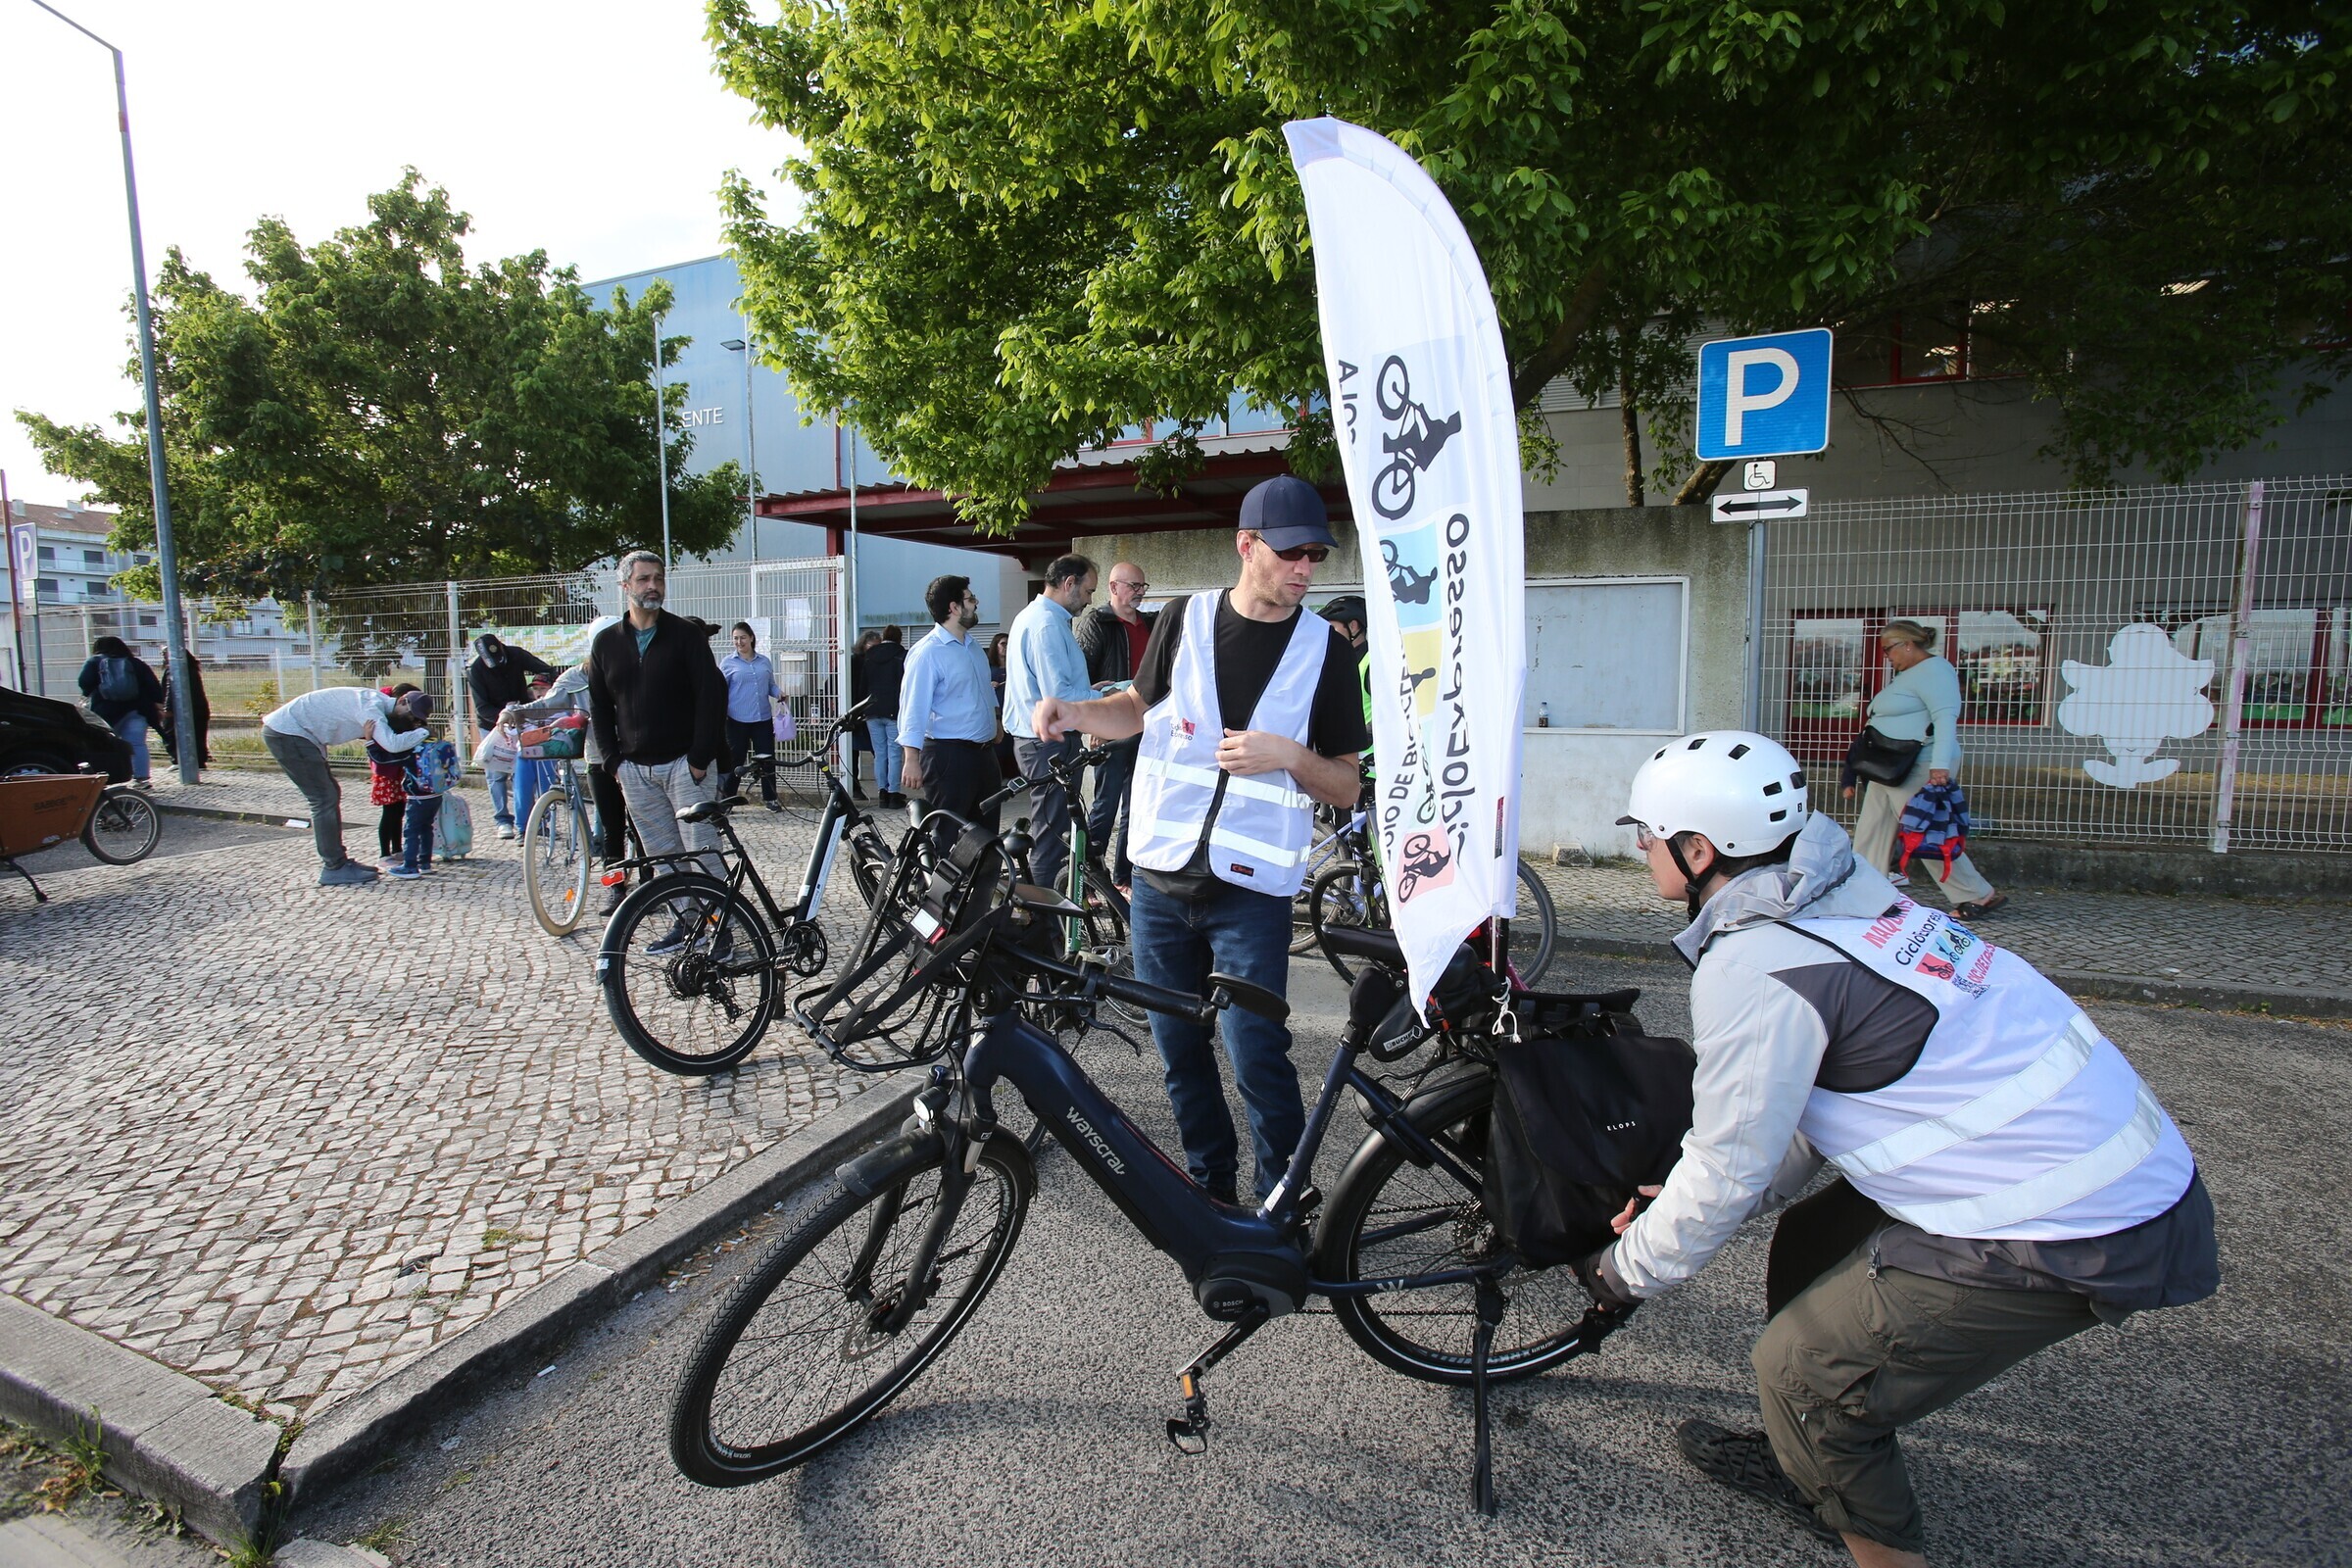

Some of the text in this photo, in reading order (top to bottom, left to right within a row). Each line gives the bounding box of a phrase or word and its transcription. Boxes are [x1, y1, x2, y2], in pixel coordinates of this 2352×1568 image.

[1724, 346, 1799, 448] P
[676, 407, 723, 428] ENTE
[18, 530, 32, 575] P
[1066, 1105, 1126, 1175] wayscral
[1607, 1120, 1636, 1131] ELOPS
[1222, 1298, 1244, 1307] BOSCH
